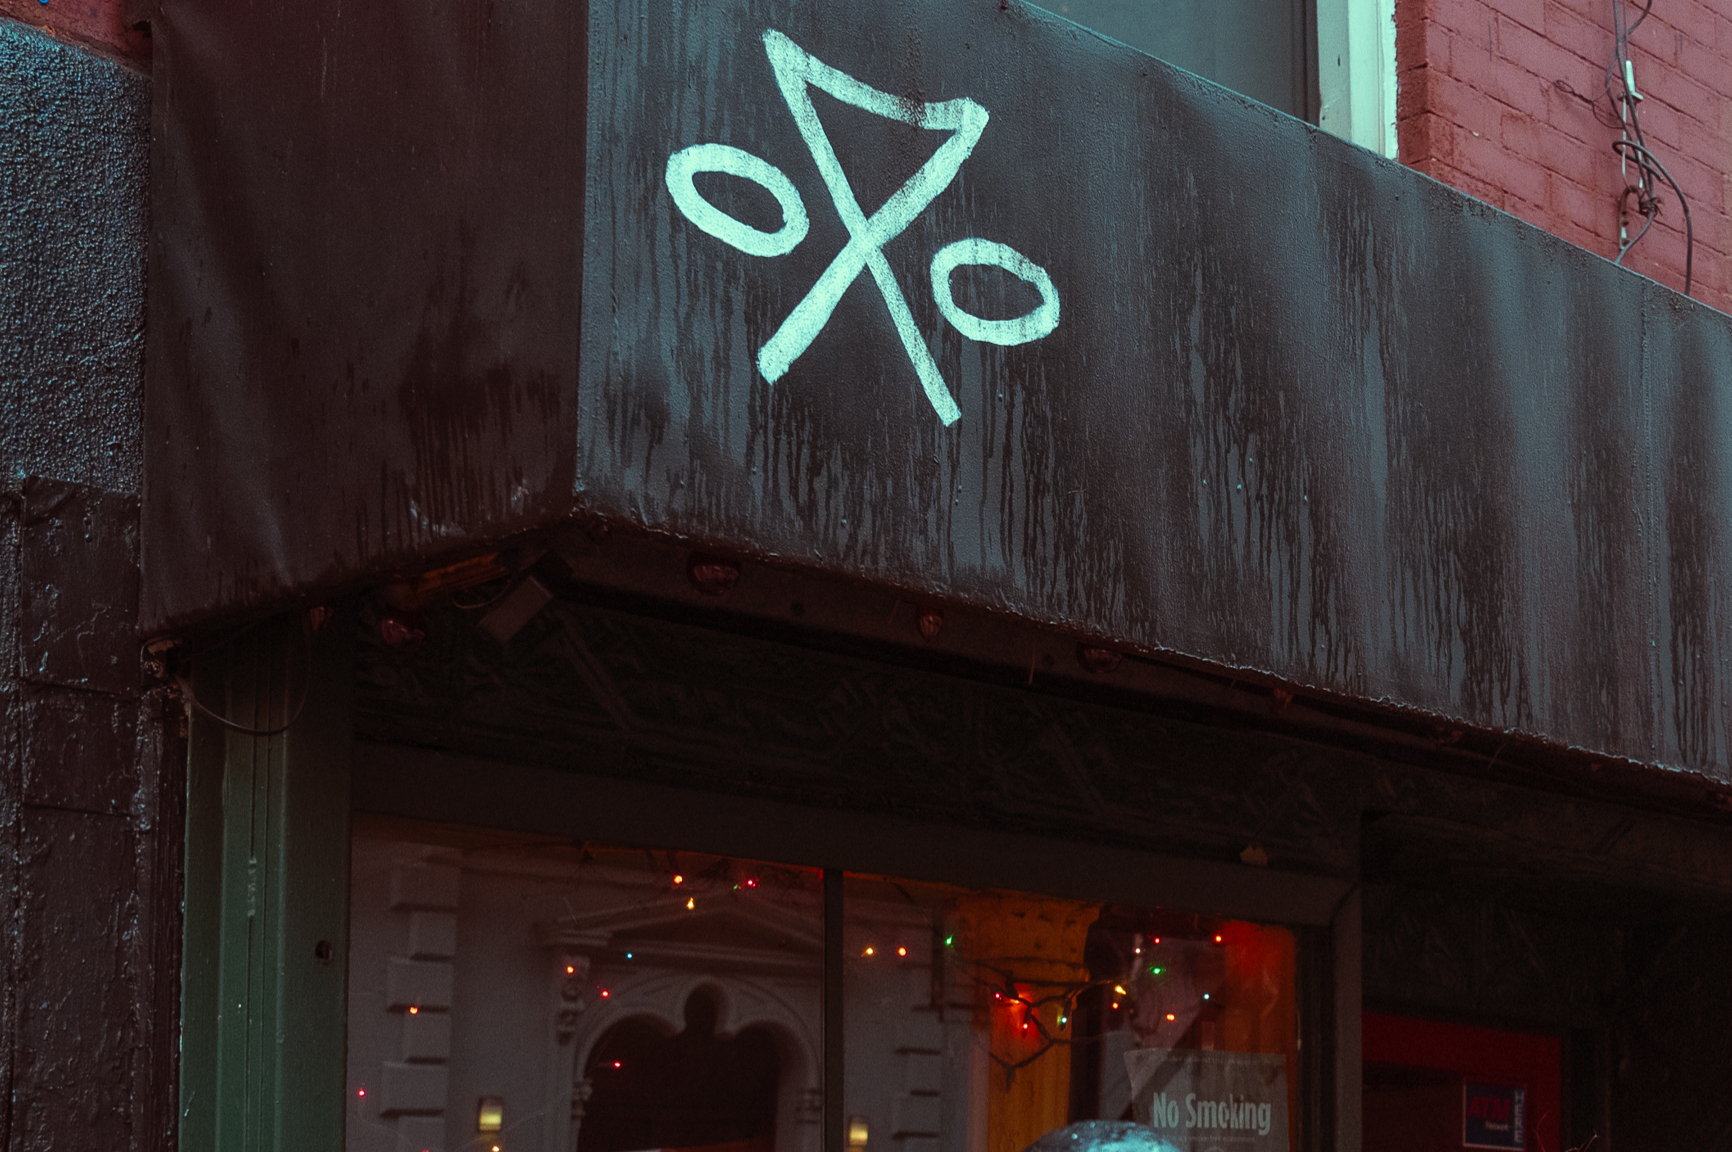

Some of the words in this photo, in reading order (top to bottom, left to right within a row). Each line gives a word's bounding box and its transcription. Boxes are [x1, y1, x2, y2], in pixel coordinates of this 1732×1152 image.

[1153, 1092, 1180, 1128] No
[1185, 1092, 1272, 1136] Smoking
[1467, 1096, 1512, 1123] ATM
[1514, 1089, 1526, 1144] HERE
